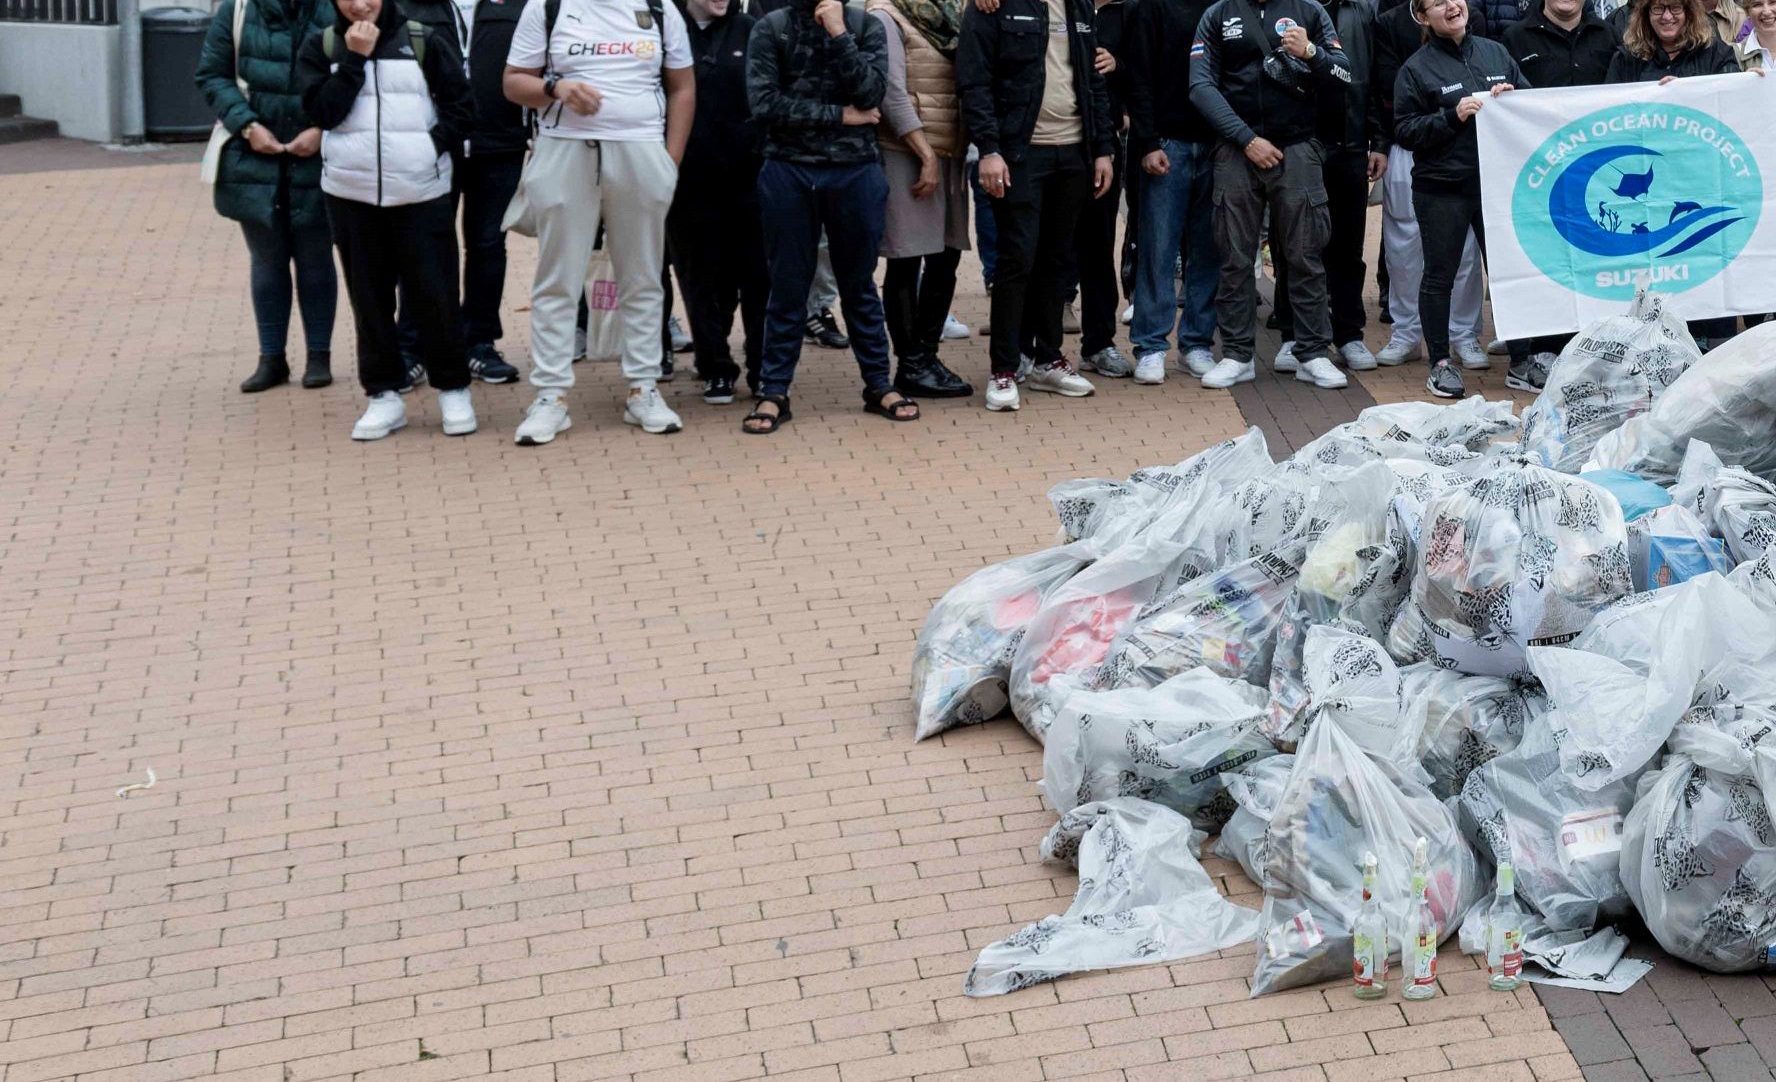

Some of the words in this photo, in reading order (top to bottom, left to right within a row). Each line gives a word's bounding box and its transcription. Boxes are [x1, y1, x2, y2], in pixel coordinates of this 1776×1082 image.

[567, 40, 655, 59] CHECK24
[1528, 129, 1588, 189] CLEAN
[1591, 113, 1668, 137] OCEAN
[1673, 116, 1750, 178] PROJECT
